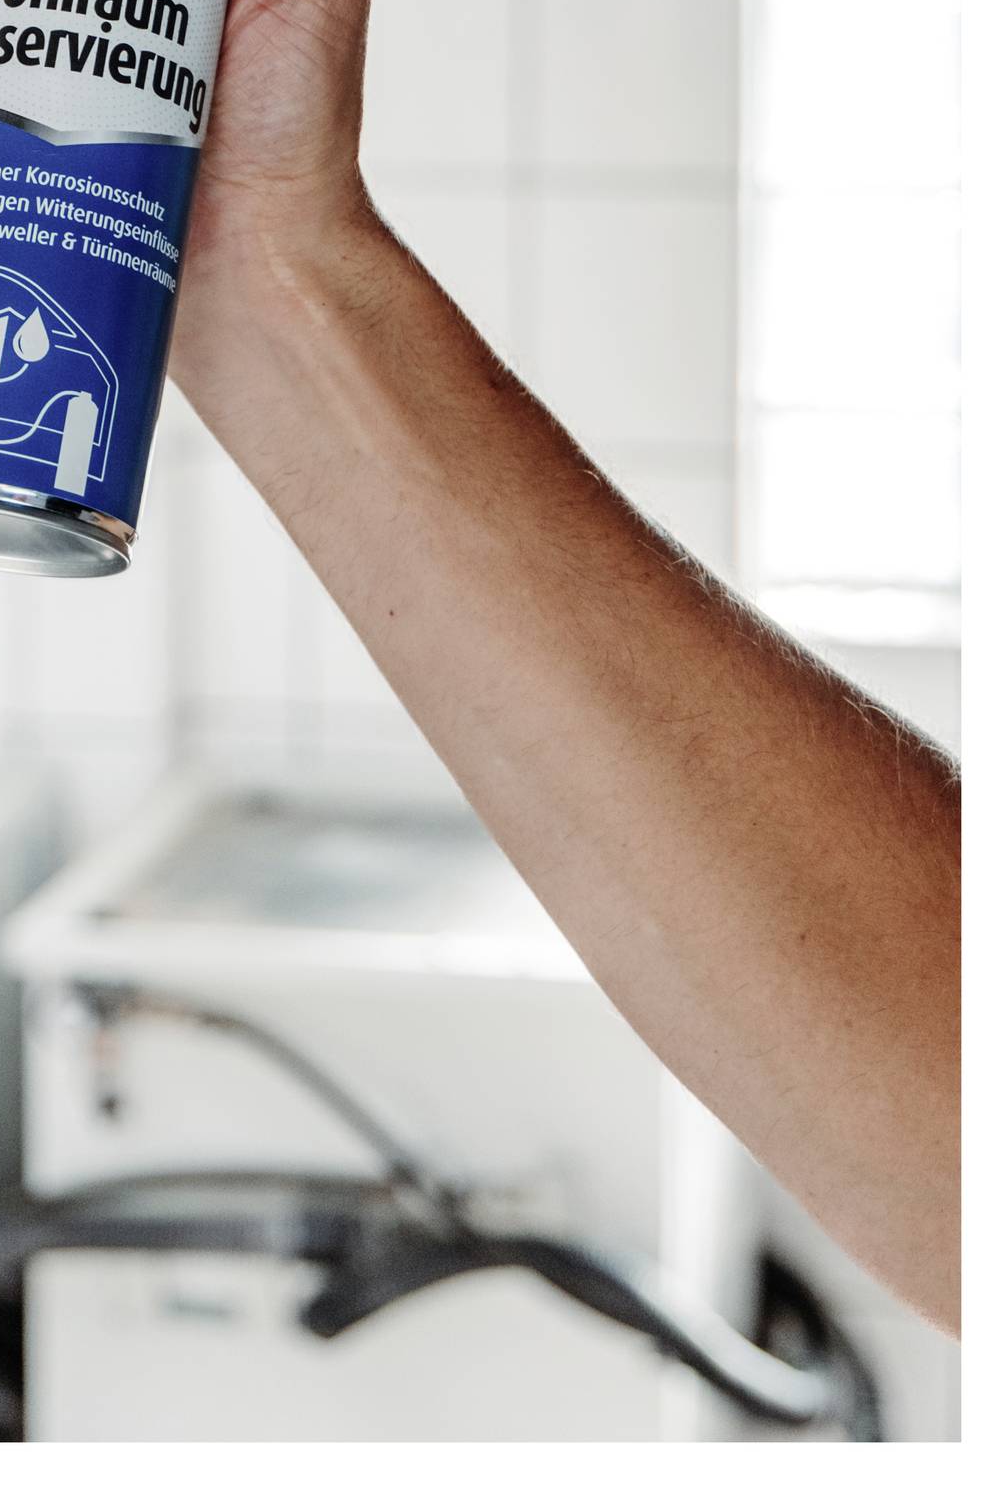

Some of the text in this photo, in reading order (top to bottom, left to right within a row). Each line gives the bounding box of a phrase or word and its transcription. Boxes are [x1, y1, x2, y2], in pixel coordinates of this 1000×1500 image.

[25, 165, 166, 222] Korrosionsschutz
[36, 196, 180, 263] Witterungseinflüsse
[61, 232, 77, 250] &
[81, 236, 177, 294] Türinnenräume
